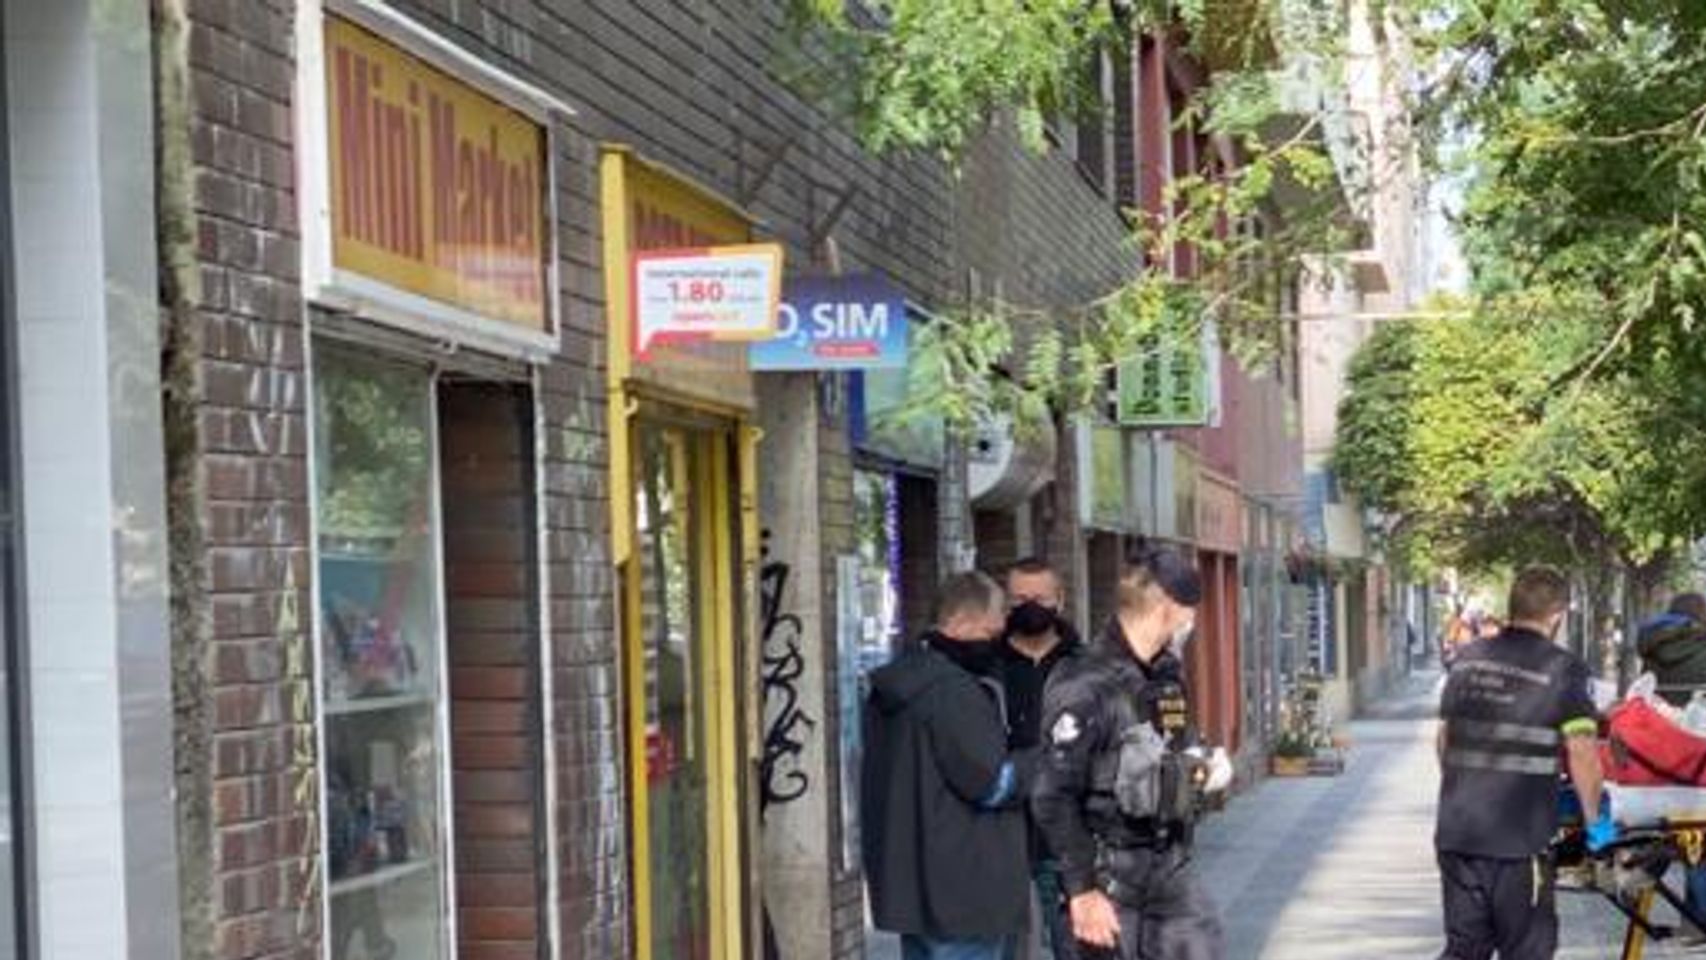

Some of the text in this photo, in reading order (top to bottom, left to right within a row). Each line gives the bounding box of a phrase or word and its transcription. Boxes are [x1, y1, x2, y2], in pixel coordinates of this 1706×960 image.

[335, 45, 425, 261] Mini
[667, 280, 725, 303] 1.80
[811, 302, 888, 338] SIM
